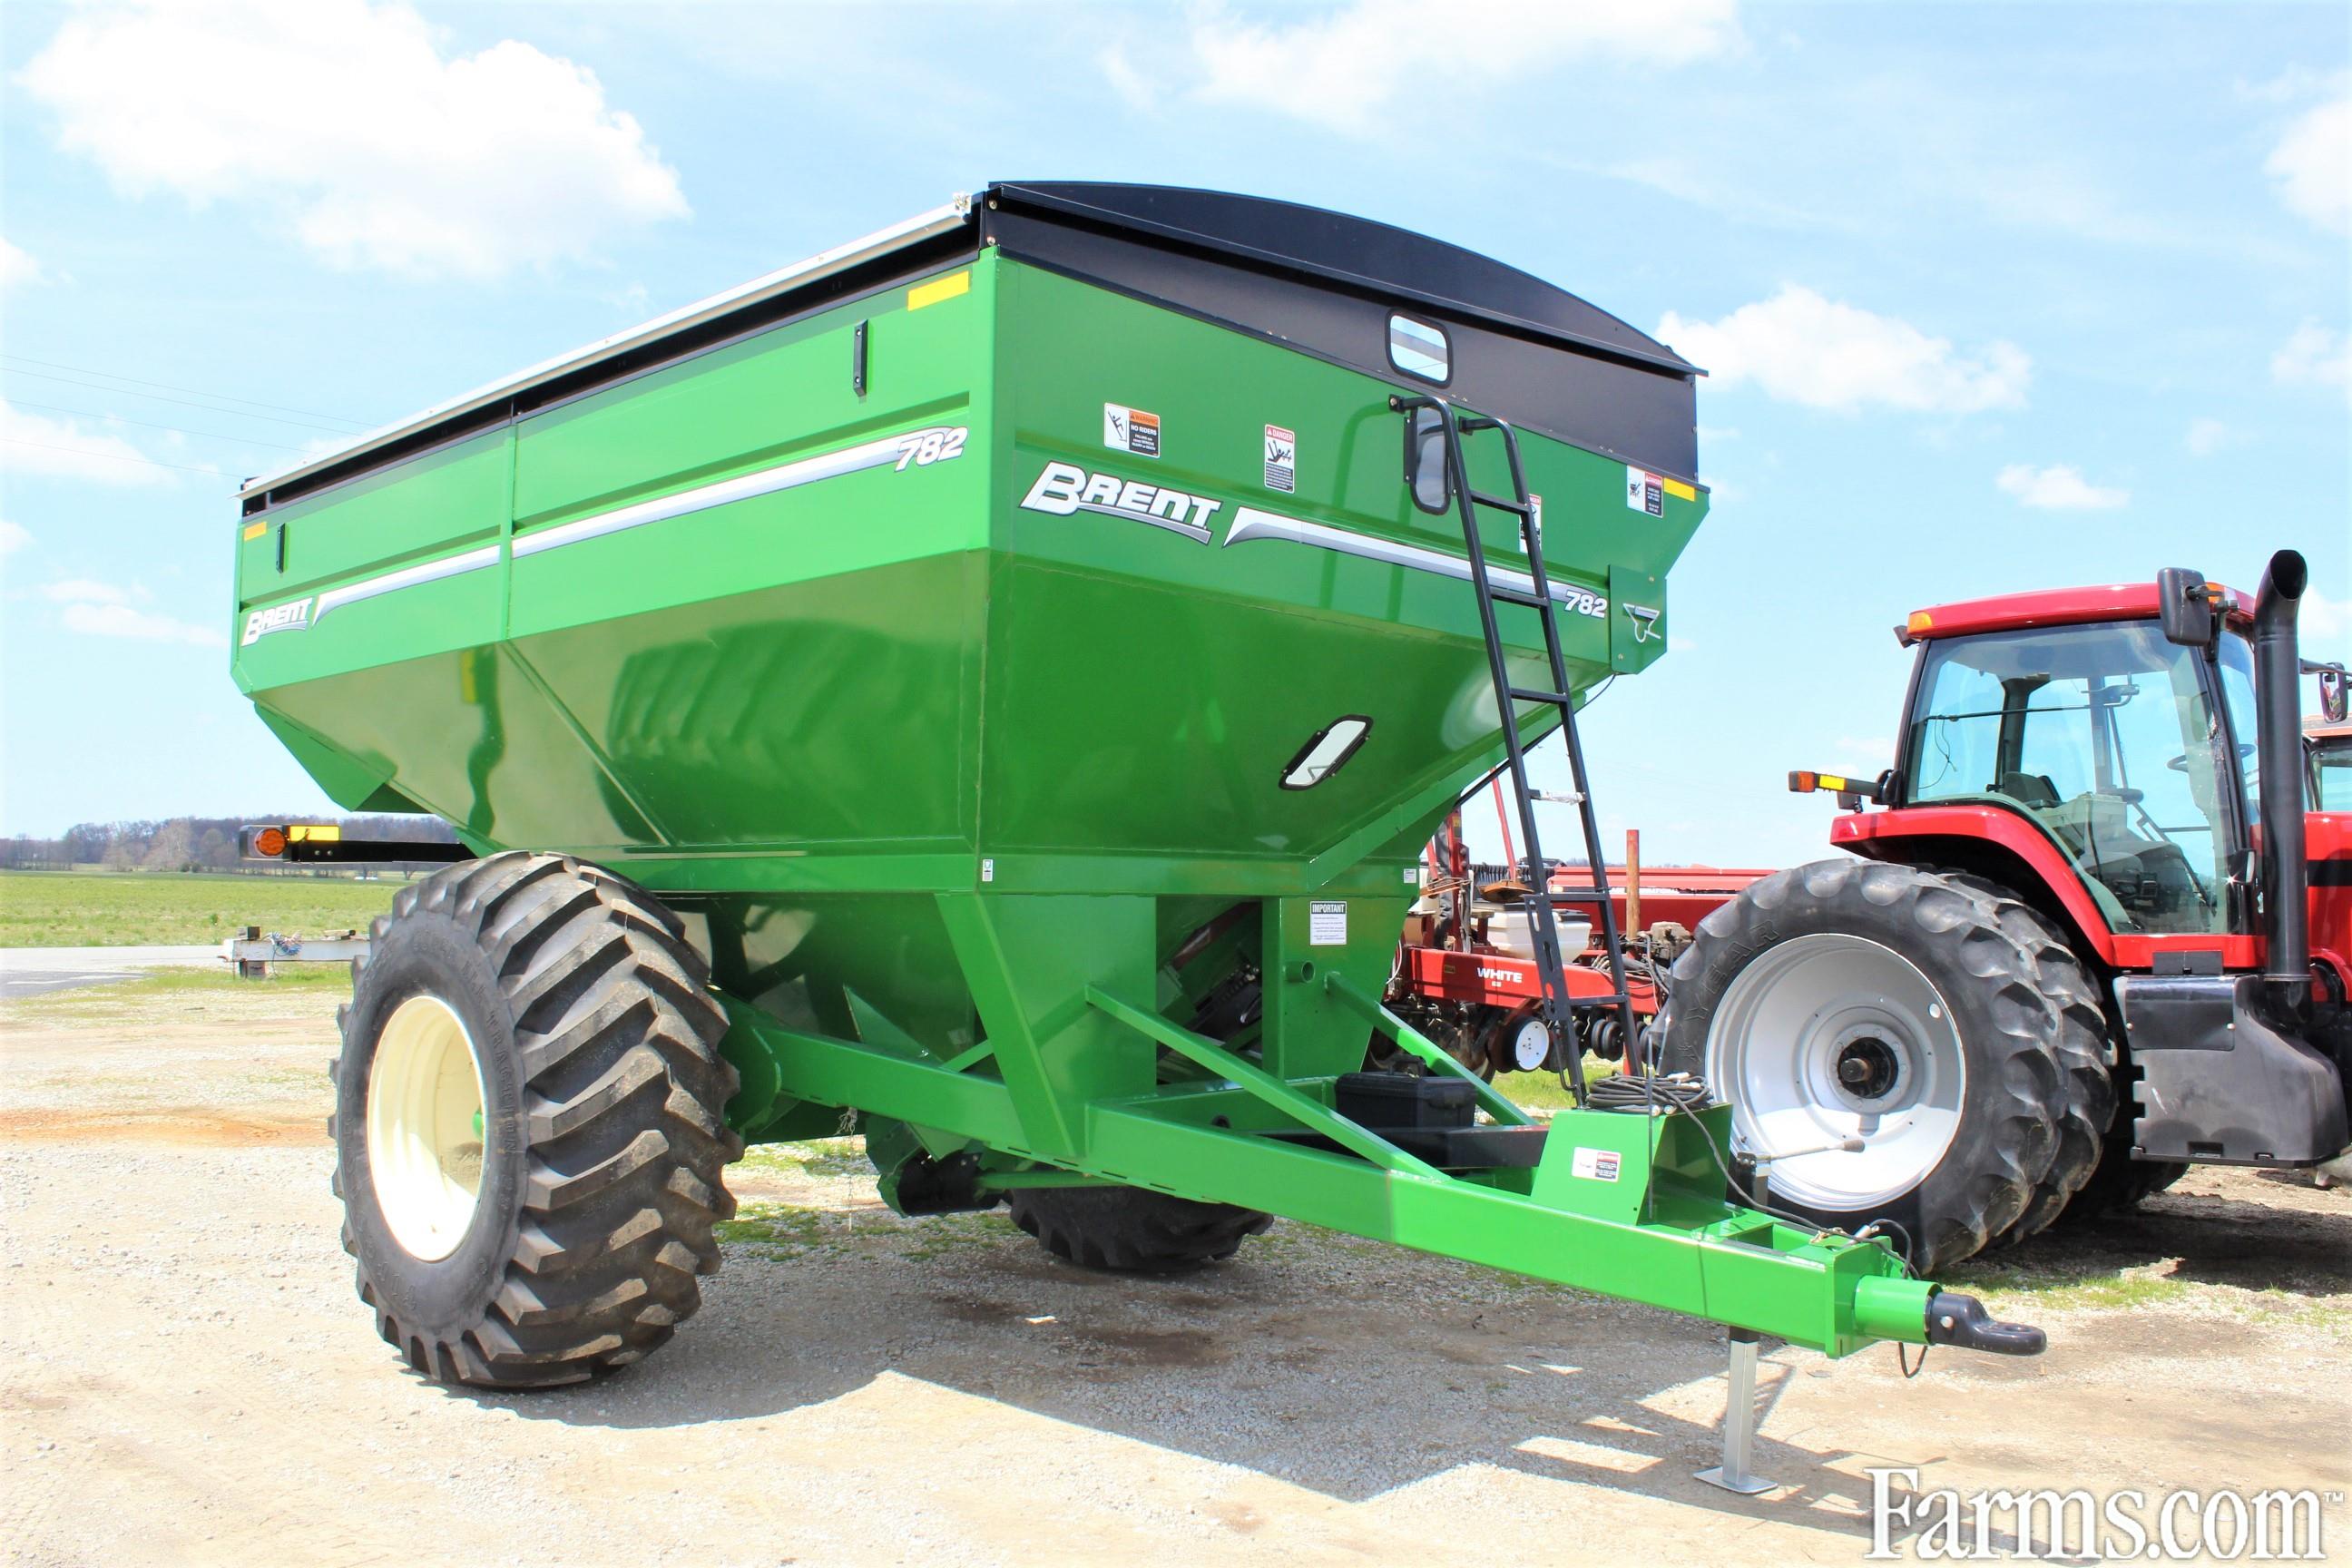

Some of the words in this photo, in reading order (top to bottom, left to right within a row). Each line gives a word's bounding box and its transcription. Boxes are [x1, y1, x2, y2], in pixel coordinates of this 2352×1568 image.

[1139, 426, 1157, 436] RIDERS
[1272, 429, 1293, 442] DANGER
[894, 426, 968, 472] 782
[1020, 460, 1224, 530] BRENT
[1564, 590, 1608, 619] 782
[241, 597, 313, 647] BRENT
[1312, 904, 1345, 914] IMPORTANT
[1476, 967, 1523, 984] WHITE
